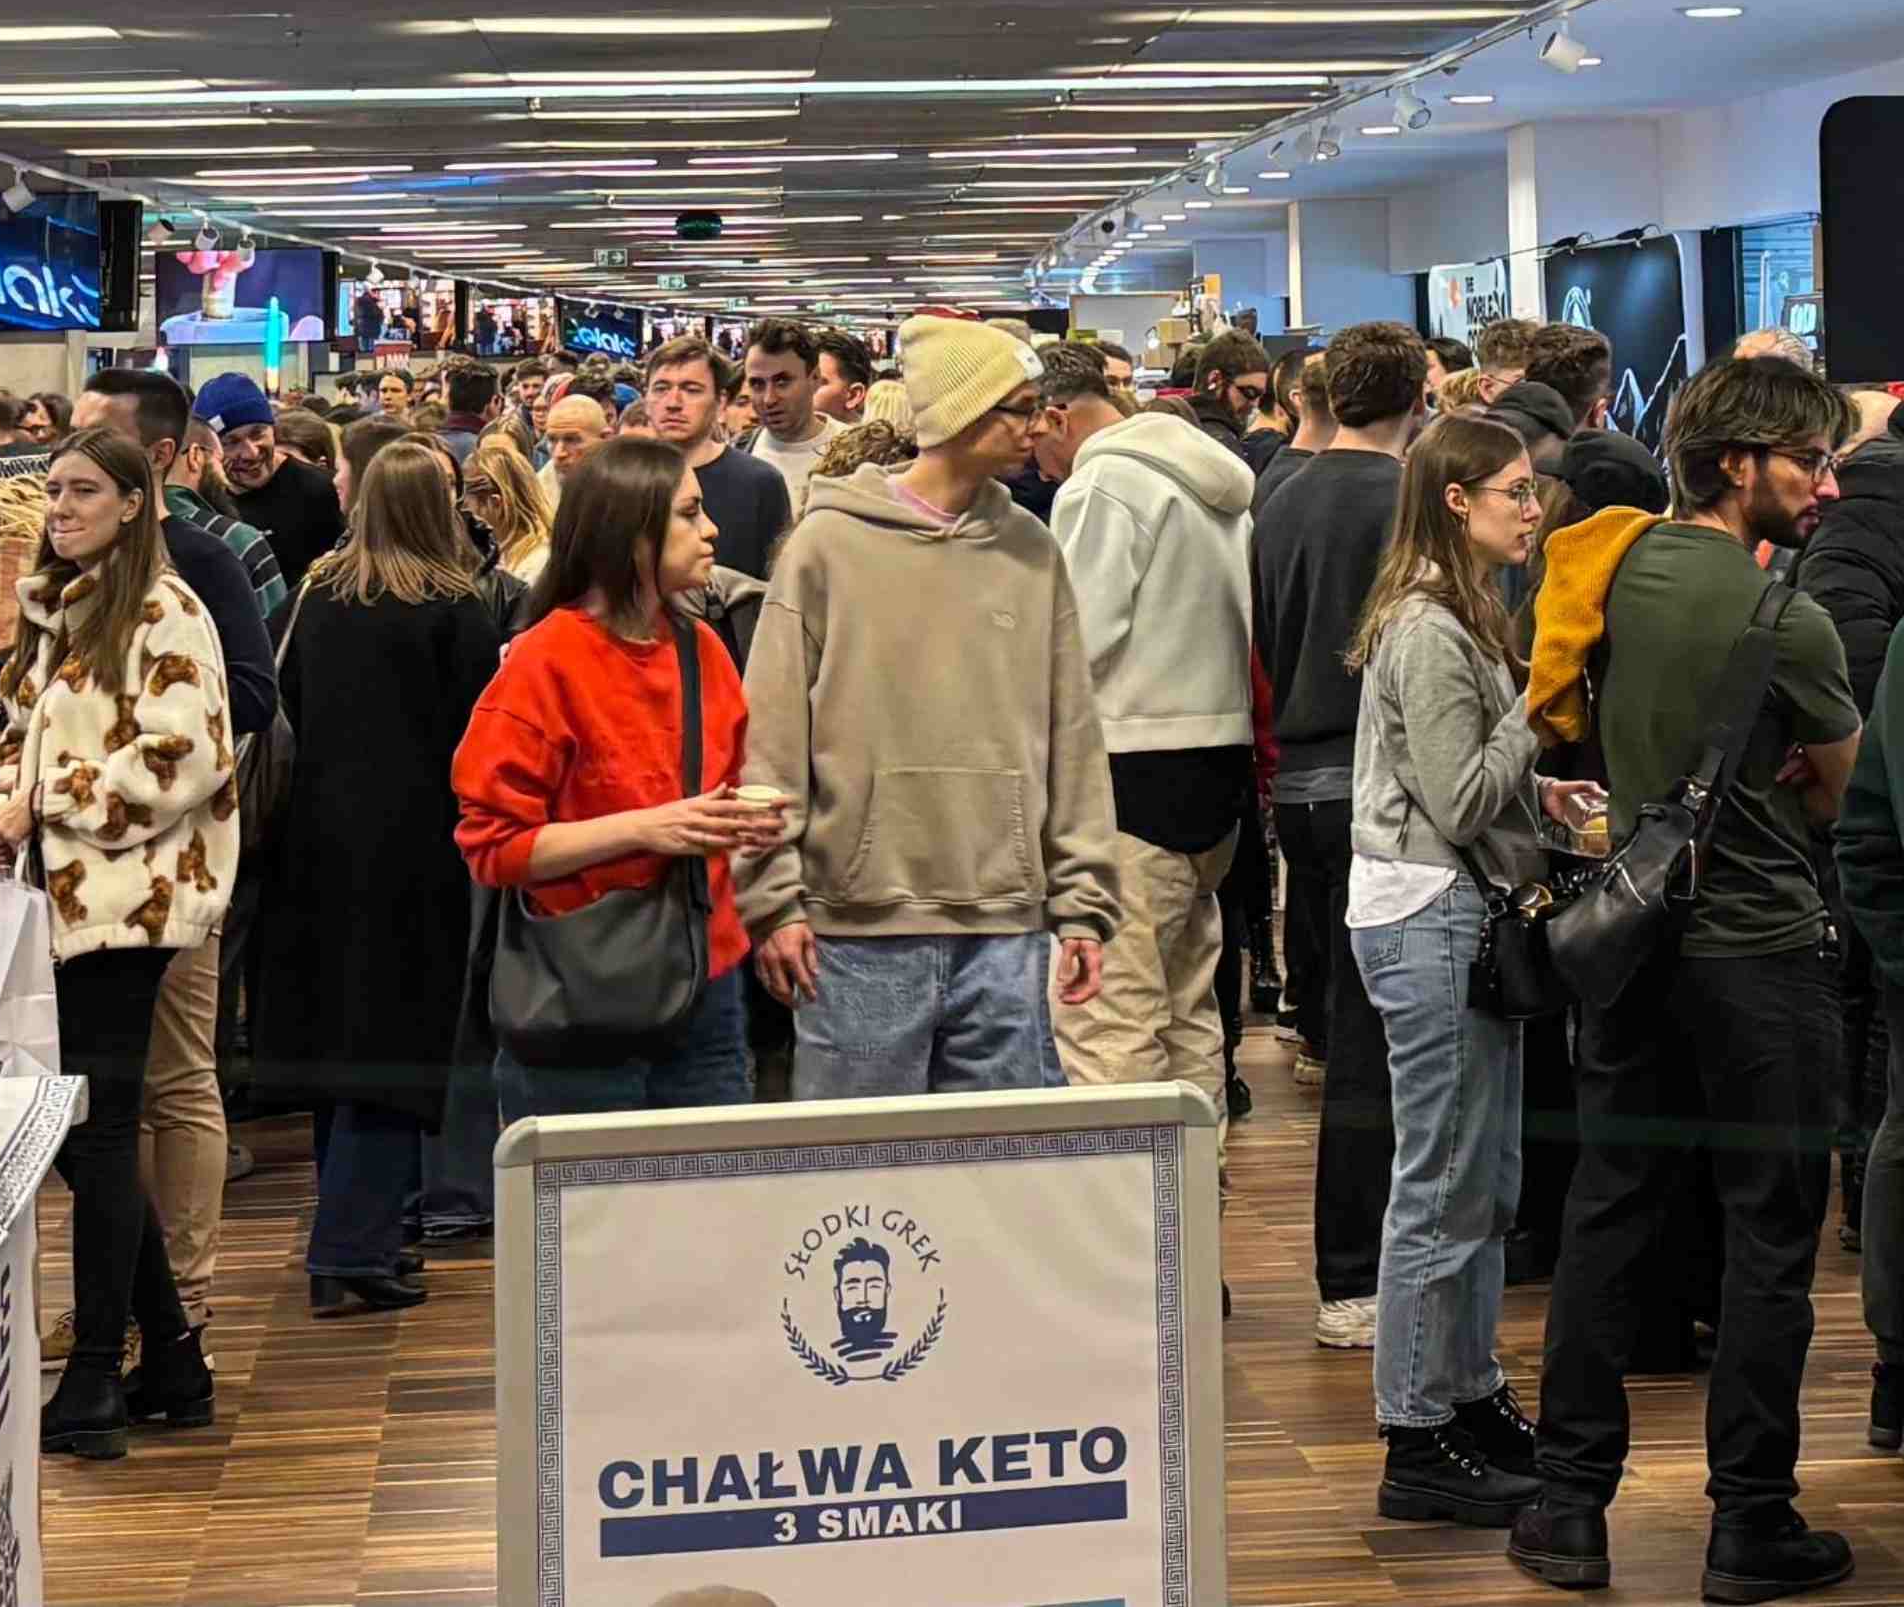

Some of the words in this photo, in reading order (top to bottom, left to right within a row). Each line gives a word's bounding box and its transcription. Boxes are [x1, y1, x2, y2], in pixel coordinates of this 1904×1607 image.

[783, 1204, 871, 1282] SŁODKI
[881, 1209, 942, 1273] GREK
[598, 1441, 913, 1510] CHAŁWA
[938, 1425, 1128, 1486] KETO
[773, 1512, 798, 1544] 3
[818, 1499, 963, 1540] SMAKI
